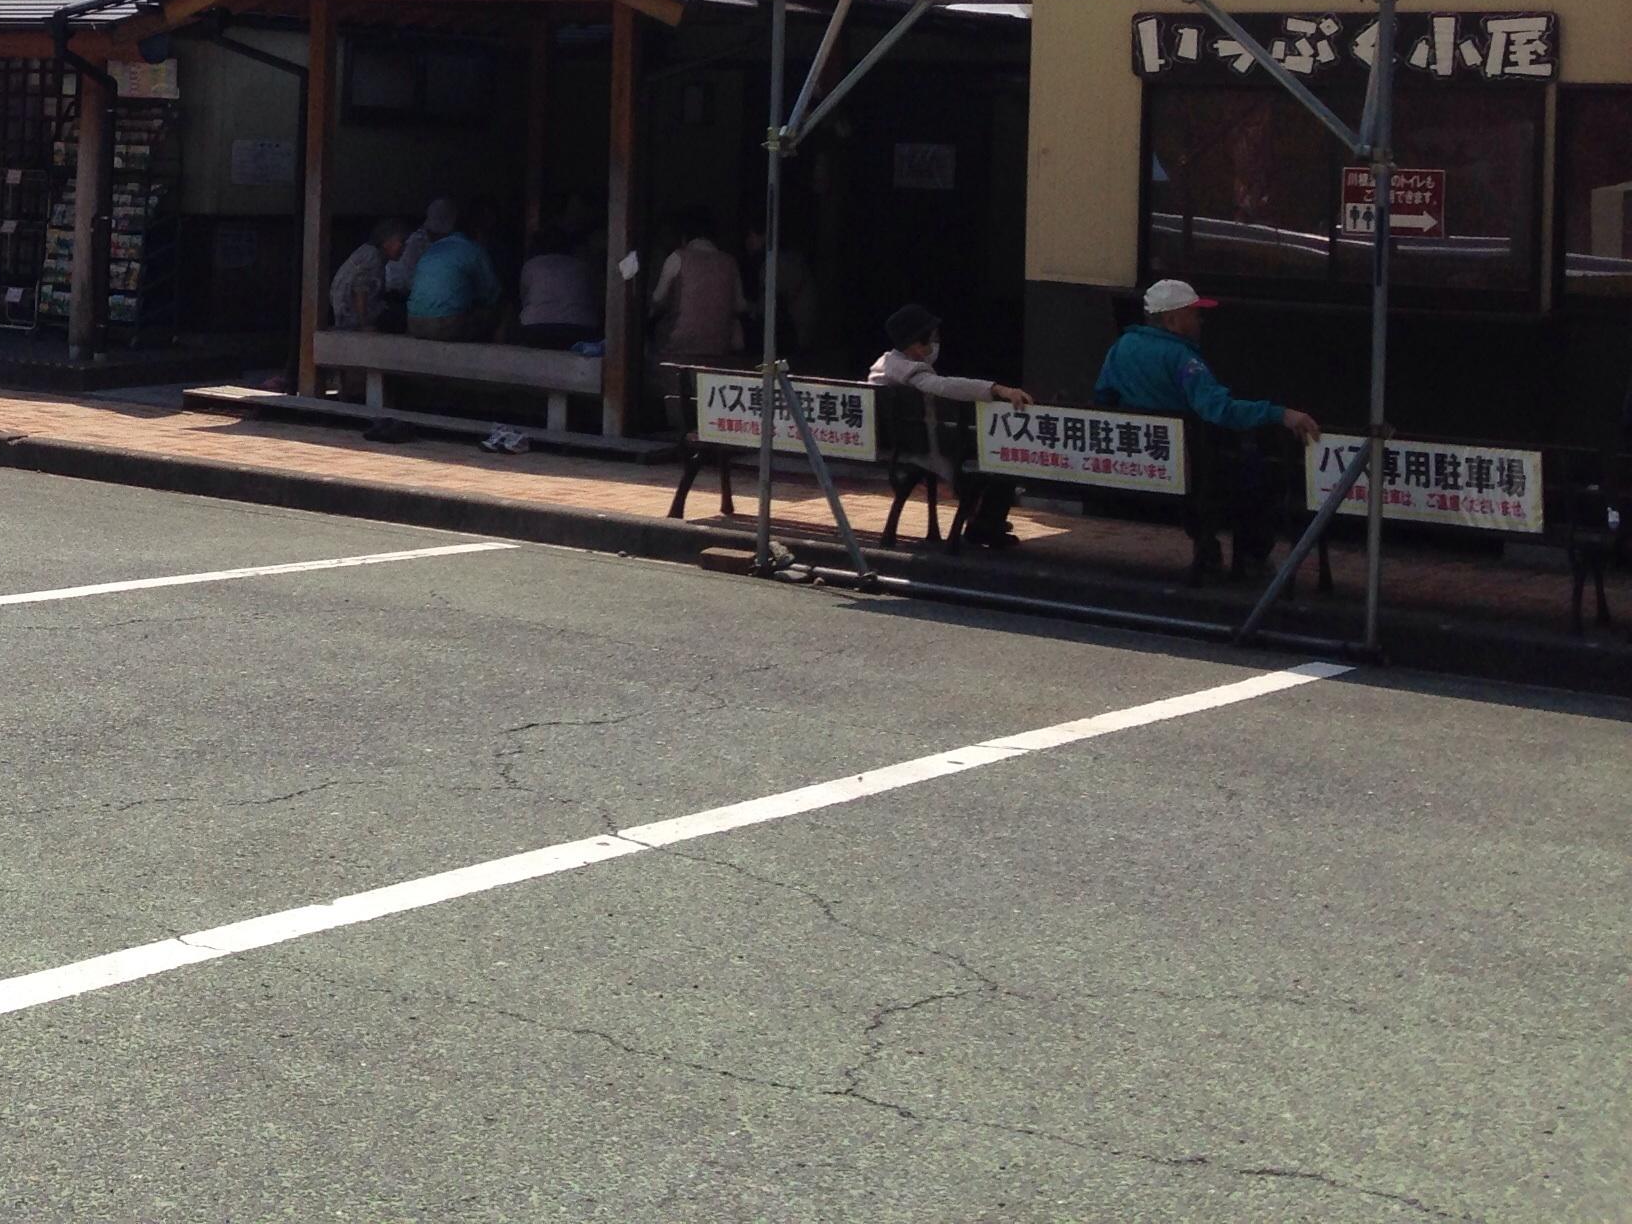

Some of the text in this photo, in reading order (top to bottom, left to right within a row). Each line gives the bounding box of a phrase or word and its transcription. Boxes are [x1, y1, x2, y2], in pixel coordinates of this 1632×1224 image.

[988, 412, 1171, 461] バス専用駐車場
